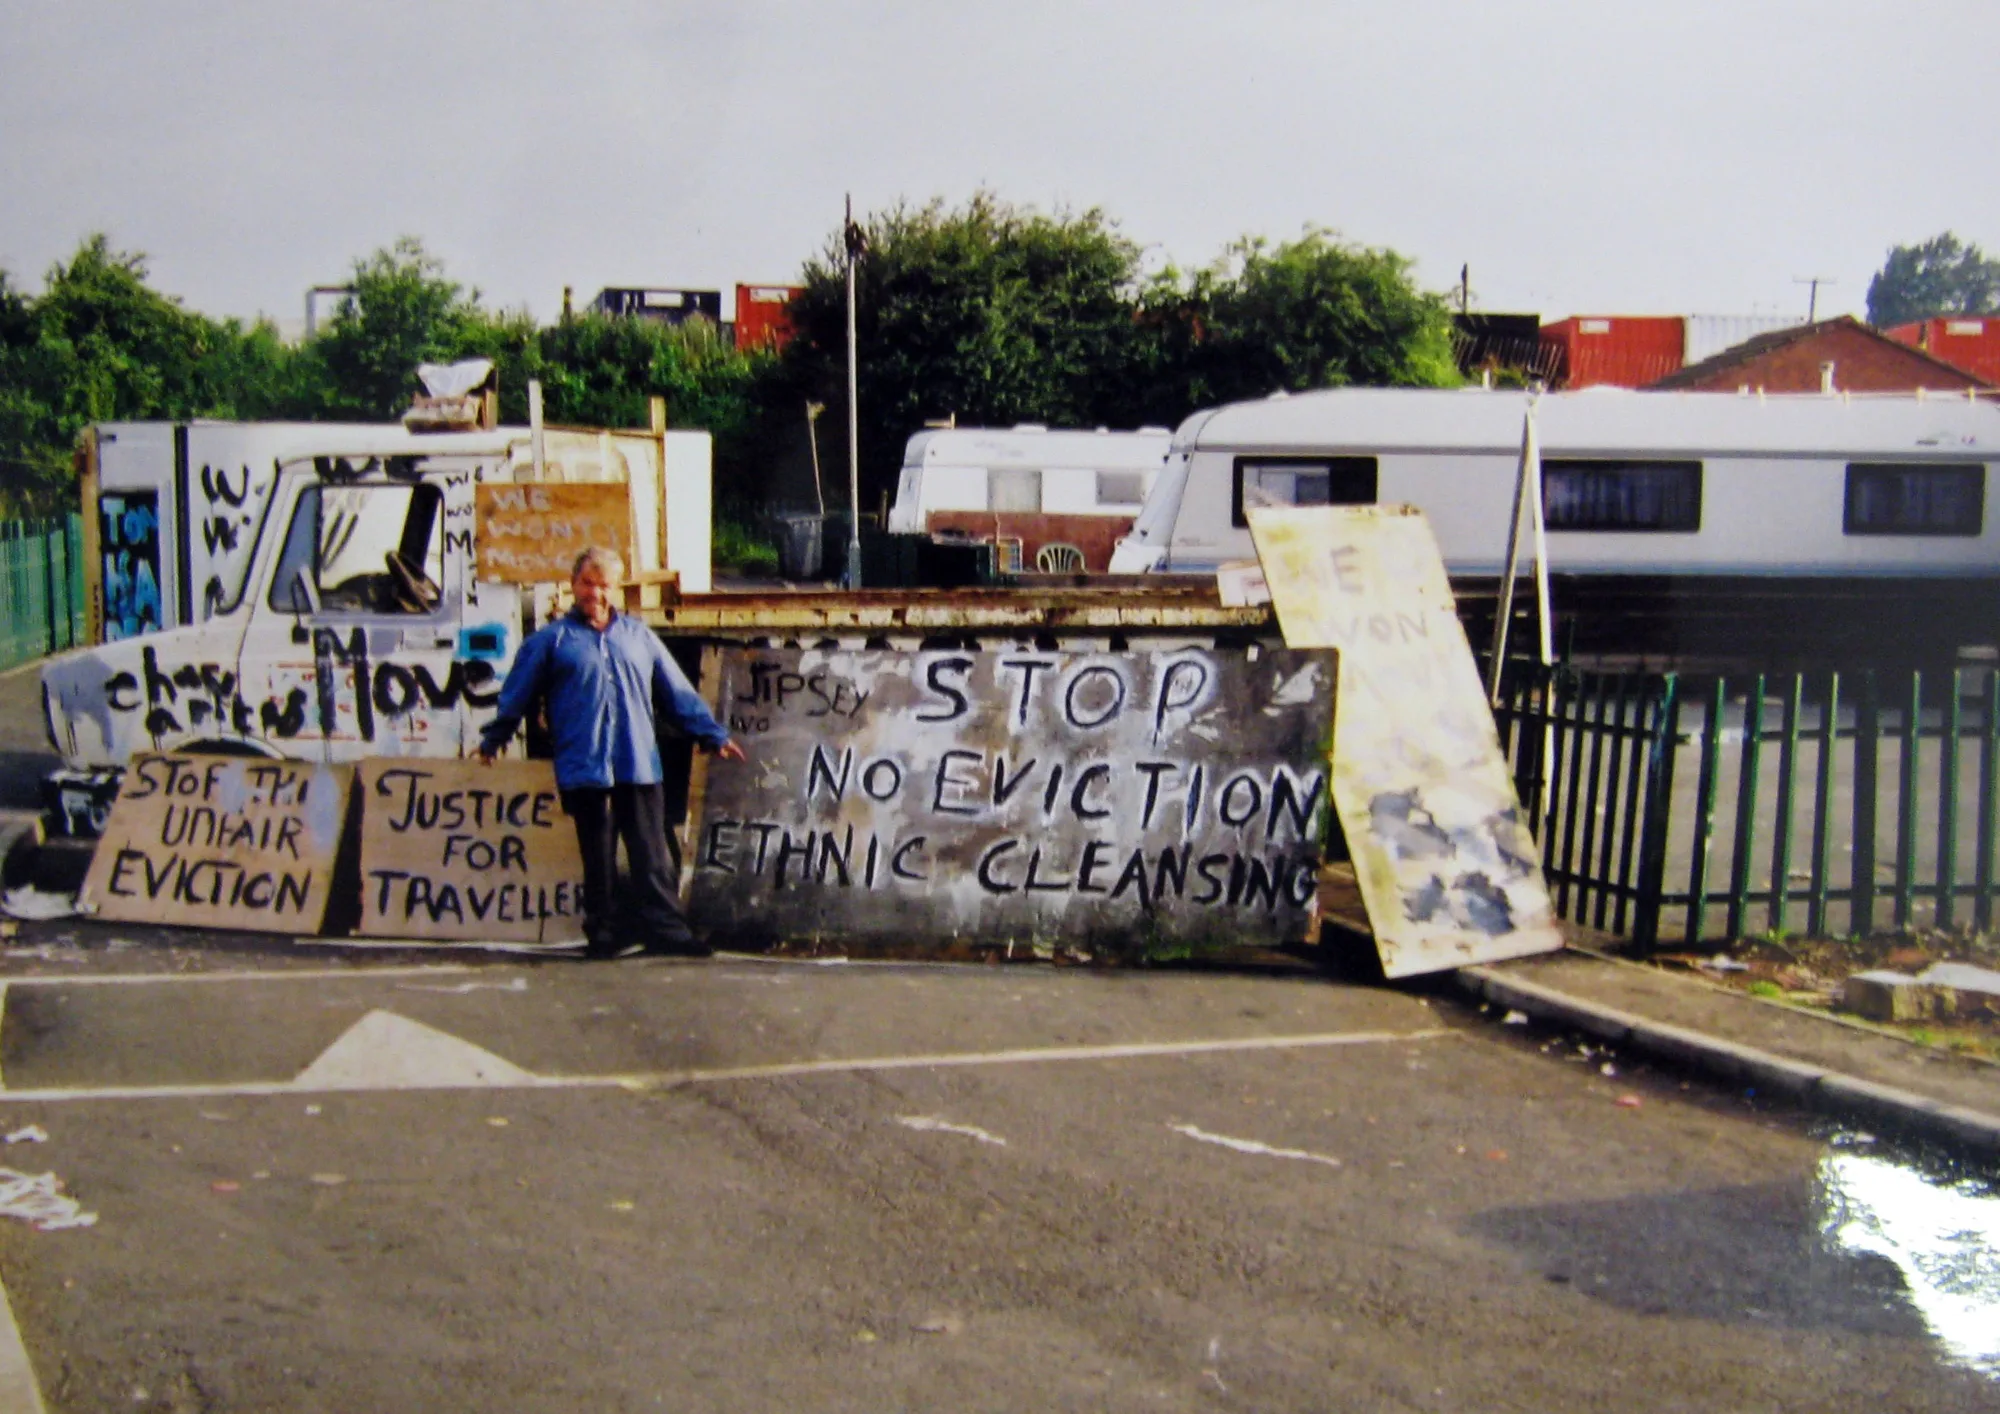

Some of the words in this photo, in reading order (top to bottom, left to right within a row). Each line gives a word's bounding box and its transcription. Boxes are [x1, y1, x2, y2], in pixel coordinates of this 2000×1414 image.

[916, 656, 1209, 745] STOP
[376, 768, 556, 832] JUSTICE
[808, 743, 901, 803] NO
[932, 751, 1323, 839] EVICTION
[109, 848, 312, 914] EVICTION
[442, 835, 528, 873] FOR
[706, 820, 928, 888] ETHNIC
[978, 839, 1320, 909] CLEANSING
